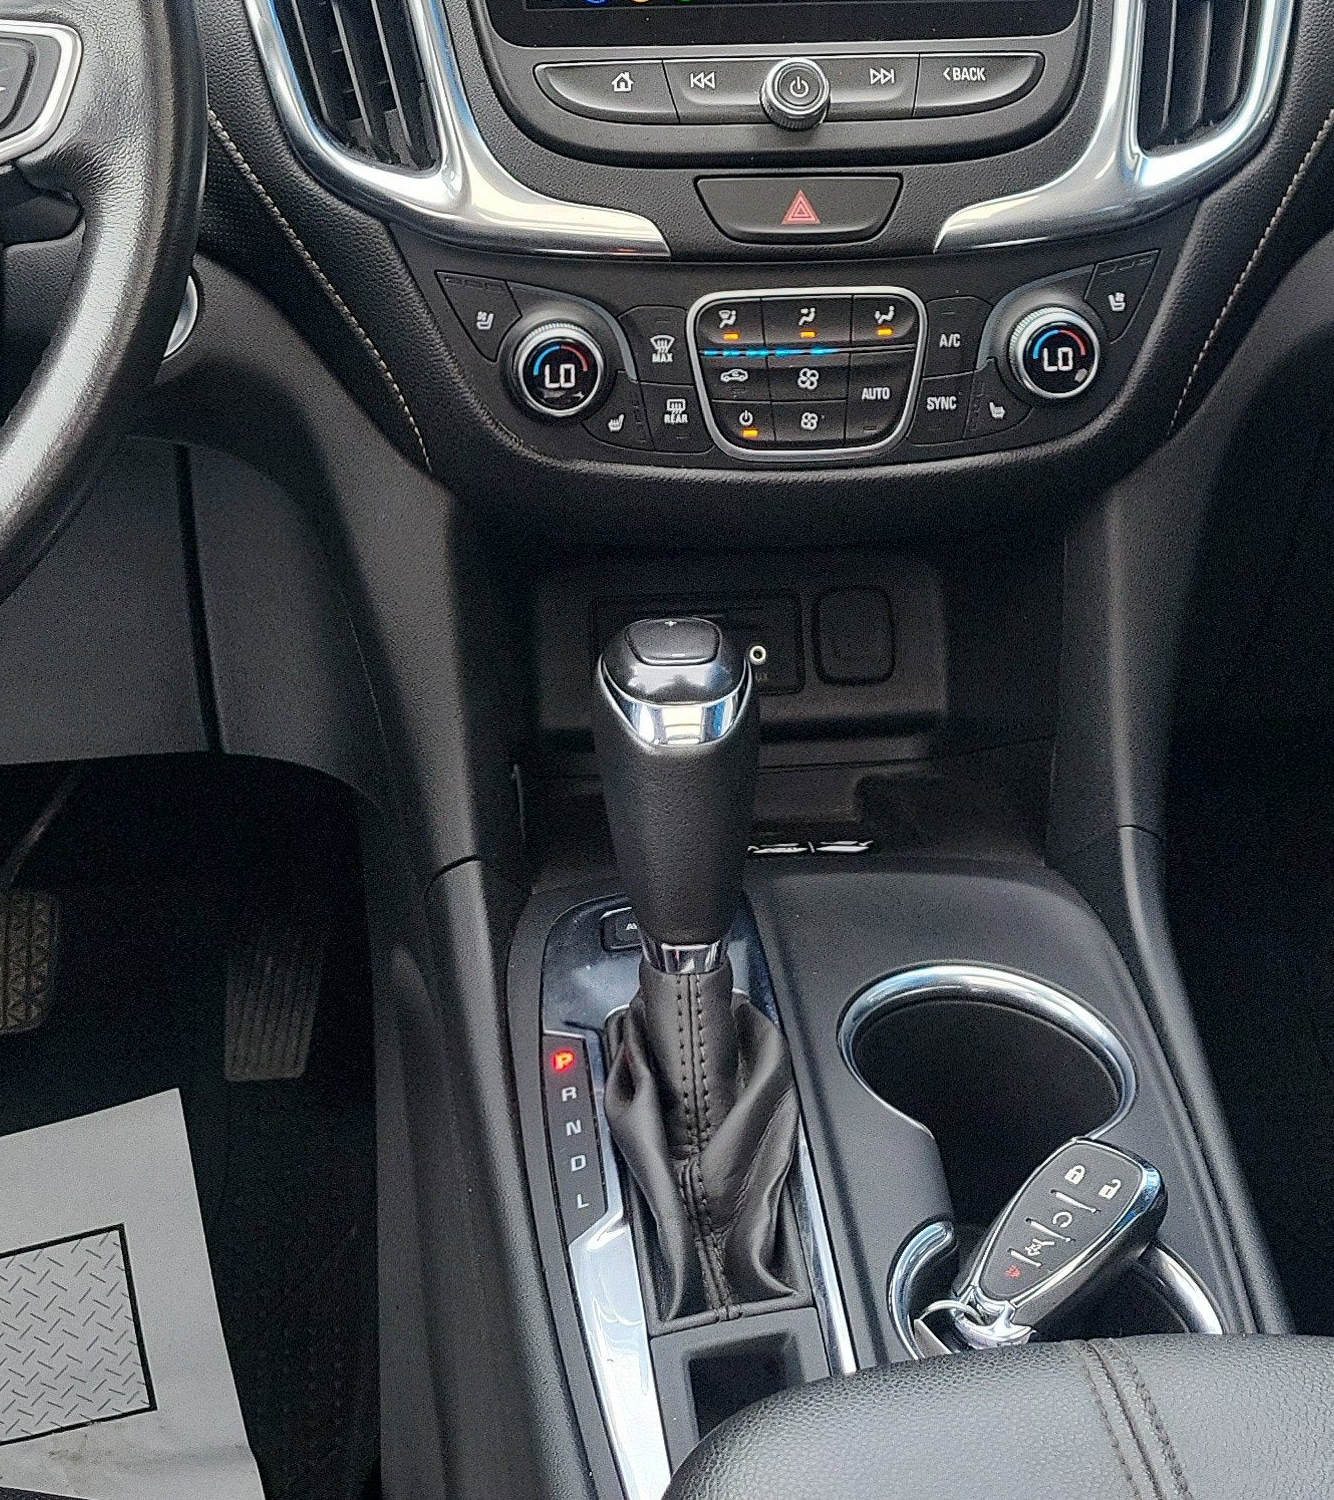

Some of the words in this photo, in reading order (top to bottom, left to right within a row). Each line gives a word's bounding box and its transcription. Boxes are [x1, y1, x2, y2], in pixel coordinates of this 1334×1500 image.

[952, 67, 986, 81] BACK
[939, 333, 961, 348] A/C
[652, 353, 673, 363] MAX
[861, 388, 891, 400] AUTO
[926, 396, 957, 411] SYNC
[664, 413, 688, 425] REAR
[553, 1050, 574, 1070] P
[562, 1087, 577, 1101] R
[566, 1121, 582, 1136] N
[571, 1155, 587, 1171] D
[576, 1193, 590, 1209] L
